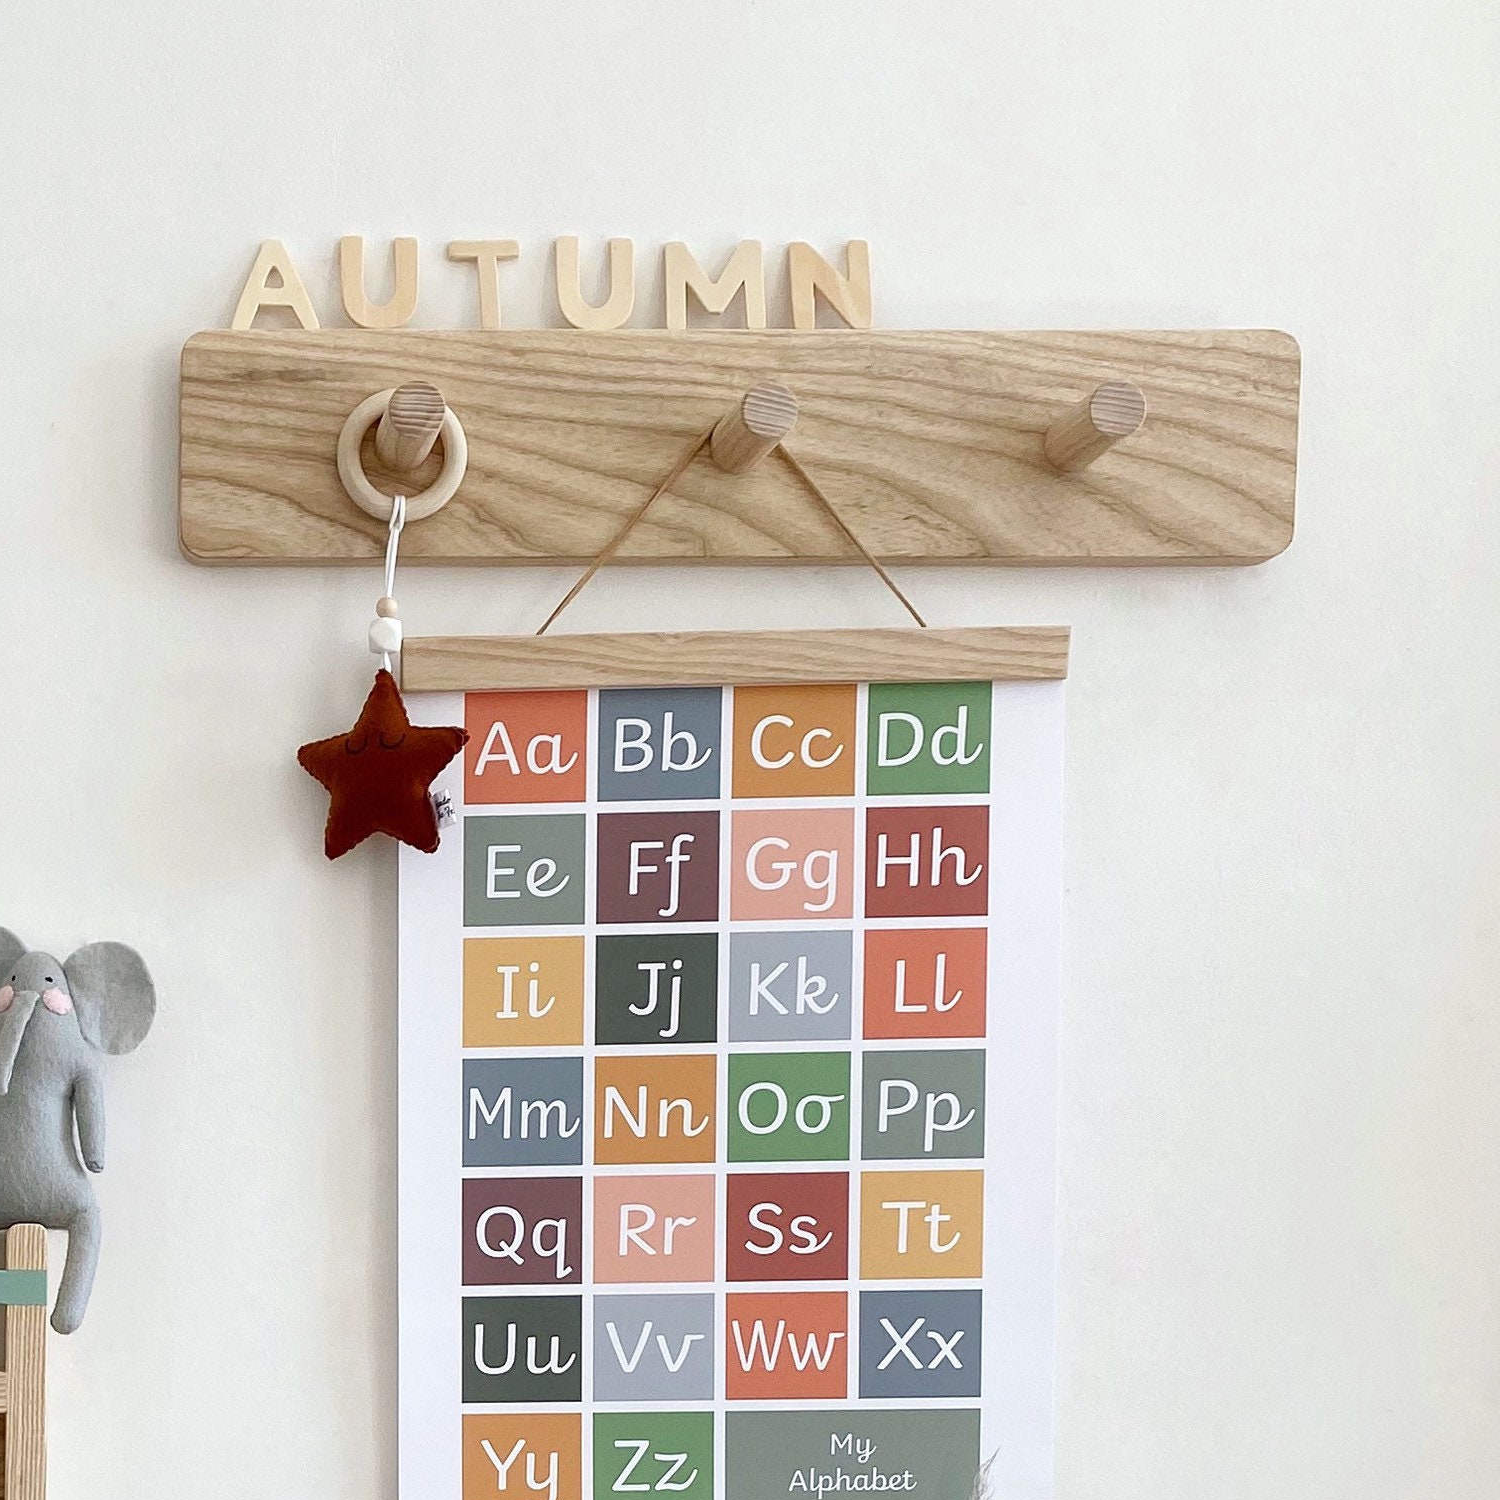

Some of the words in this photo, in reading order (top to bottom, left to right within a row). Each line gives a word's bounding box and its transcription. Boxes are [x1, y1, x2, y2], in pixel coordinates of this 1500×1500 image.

[231, 236, 873, 329] AUTUMN
[474, 721, 578, 776] Aa
[614, 711, 712, 773] Bb
[751, 714, 844, 769] Cc
[877, 705, 984, 767] Dd
[486, 844, 570, 899] Ee
[628, 833, 695, 917] Ff
[745, 837, 838, 912] Gg
[876, 827, 983, 887] Hh
[496, 962, 556, 1019] Ii
[628, 959, 683, 1038] Jj
[749, 956, 839, 1016] Kk
[894, 953, 963, 1013] Ll
[468, 1087, 581, 1140] Mm
[603, 1085, 709, 1139] Nn
[878, 1079, 976, 1152] Pp
[476, 1206, 573, 1279] Qq
[619, 1204, 697, 1256] Rr
[744, 1202, 833, 1255] Ss
[882, 1201, 961, 1254] Tt
[474, 1323, 576, 1375] Uu
[605, 1321, 705, 1373] Vv
[731, 1320, 844, 1372] Ww
[877, 1317, 965, 1370] Xx
[611, 1440, 698, 1492] Zz
[830, 1433, 877, 1459] My
[788, 1466, 918, 1500] Alphabet
